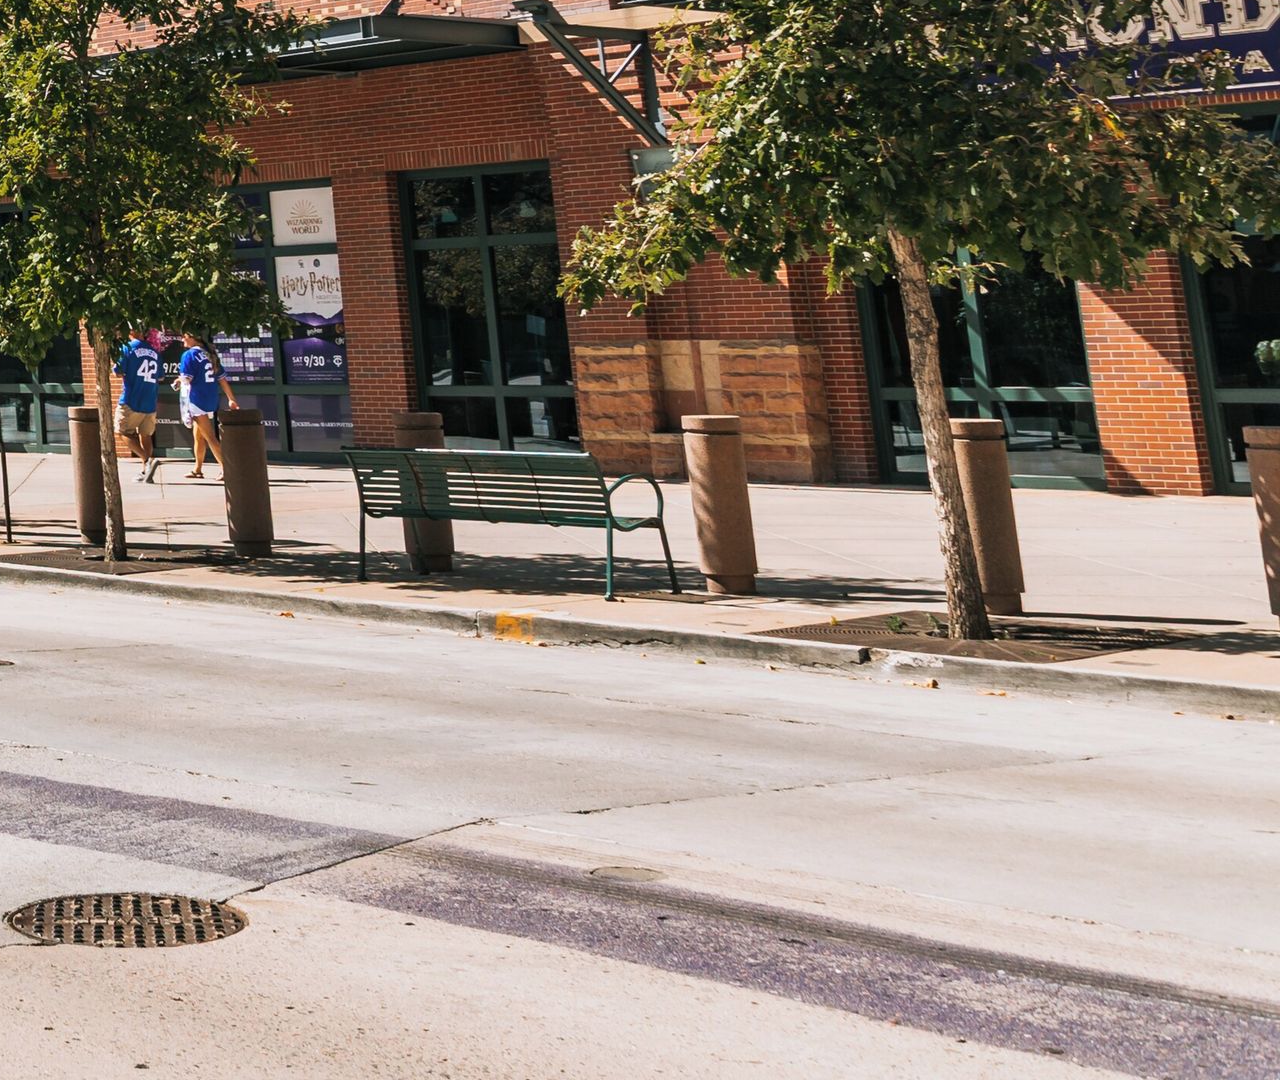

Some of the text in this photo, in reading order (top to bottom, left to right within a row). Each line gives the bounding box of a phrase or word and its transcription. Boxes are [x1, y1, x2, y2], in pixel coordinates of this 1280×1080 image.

[286, 217, 323, 226] WIZARDING
[291, 224, 320, 235] WORLD
[281, 275, 309, 299] Harry
[309, 271, 341, 299] Potter
[292, 354, 325, 368] SAT 9/30
[137, 359, 158, 384] 42
